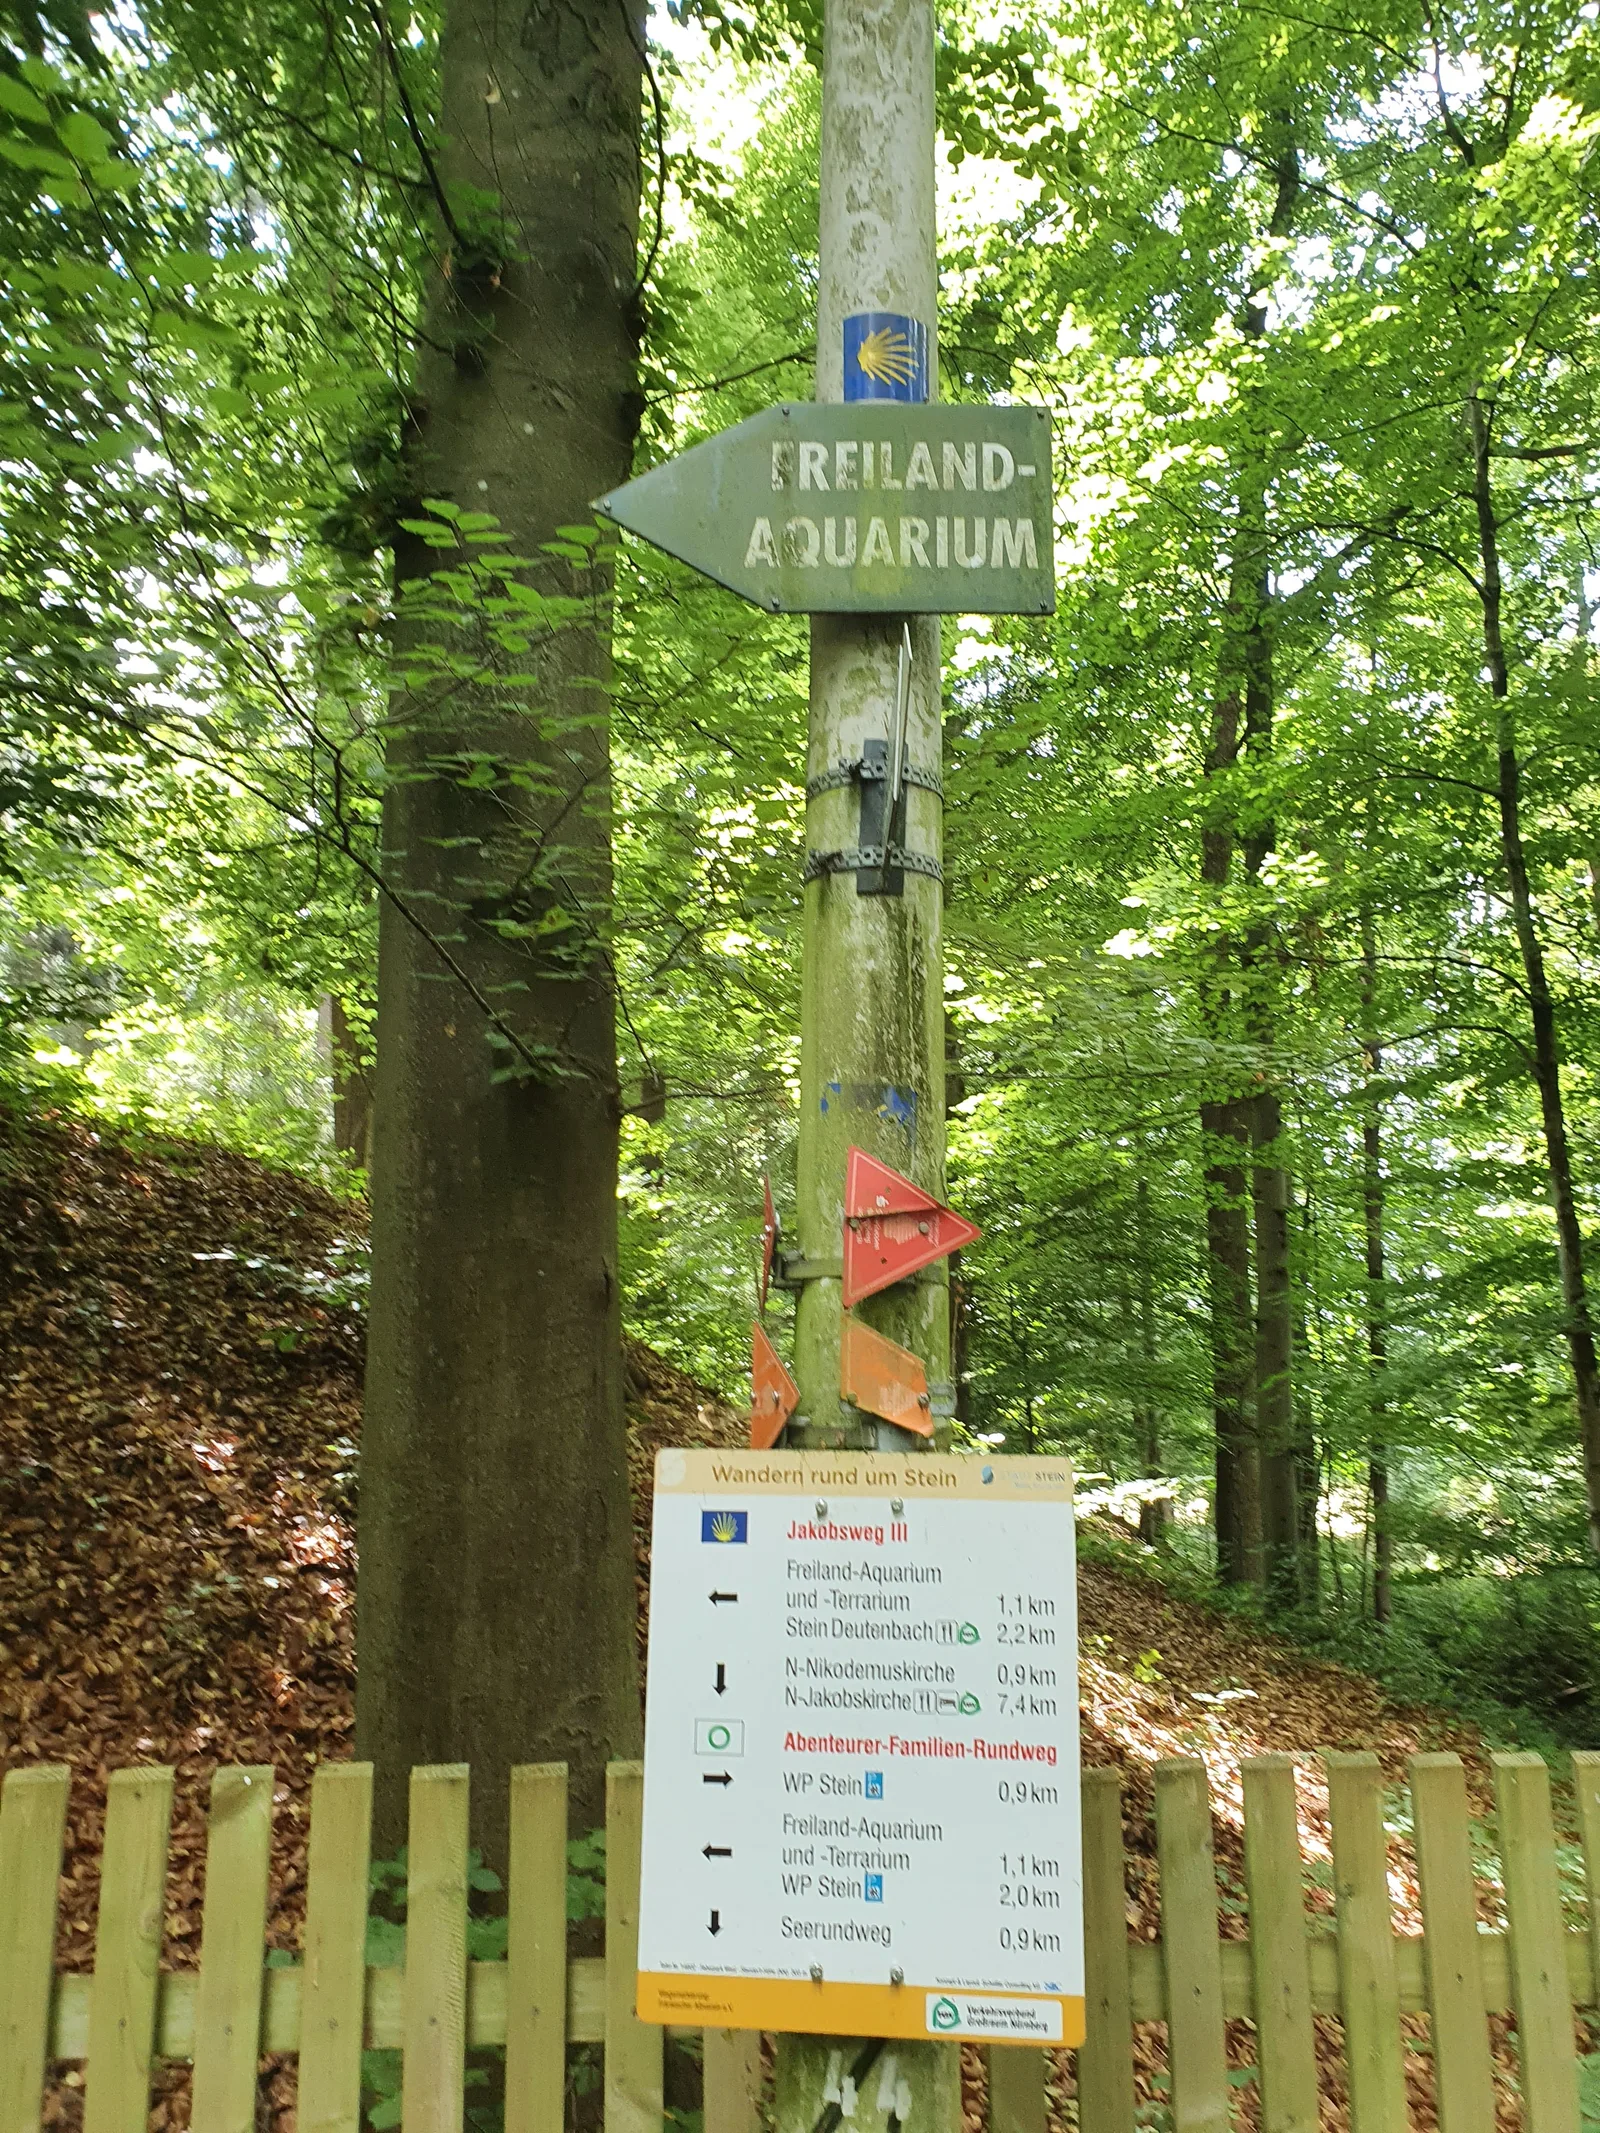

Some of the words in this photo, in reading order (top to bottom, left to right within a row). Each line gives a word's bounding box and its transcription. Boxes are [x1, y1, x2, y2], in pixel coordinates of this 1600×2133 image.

[770, 440, 1037, 492] FREILAND-
[743, 516, 1039, 569] AQUARIUM
[712, 1464, 804, 1486] Wandern
[811, 1467, 858, 1485] rund
[864, 1469, 898, 1486] um
[904, 1469, 958, 1488] Stein
[1035, 1471, 1065, 1482] STEIN
[786, 1519, 884, 1546] Jakobsweg
[786, 1557, 942, 1586] Freiland-Aquarium
[785, 1588, 818, 1610] und
[823, 1588, 911, 1612] -Terrarium
[996, 1593, 1025, 1617] 1,1
[1028, 1594, 1055, 1616] km
[784, 1615, 828, 1639] Stein
[831, 1617, 934, 1643] Deutenbach
[995, 1621, 1026, 1646] 2,2
[1028, 1623, 1056, 1646] km
[784, 1656, 956, 1684] N-Nikodemuskirche
[997, 1662, 1026, 1686] 0,9
[1029, 1664, 1057, 1687] km
[784, 1685, 912, 1712] N-Jakobskirche
[996, 1691, 1027, 1717] 7,4
[1029, 1693, 1057, 1716] km
[783, 1731, 1057, 1766] Abenteurer-Familien-Rundweg
[782, 1771, 814, 1794] WP
[819, 1773, 863, 1797] Stein
[998, 1780, 1028, 1805] 0,9
[1030, 1781, 1058, 1804] km
[782, 1812, 943, 1843] Freiland-Aquarium
[781, 1845, 815, 1868] und
[820, 1845, 911, 1871] -Terrarium
[999, 1853, 1027, 1879] 1,1
[1031, 1854, 1059, 1878] km
[781, 1873, 813, 1897] WP
[818, 1874, 862, 1900] Stein
[999, 1883, 1029, 1910] 2,0
[1031, 1885, 1060, 1909] km
[781, 1915, 892, 1947] Seerundweg
[999, 1926, 1029, 1954] 0,9
[1032, 1928, 1061, 1953] km
